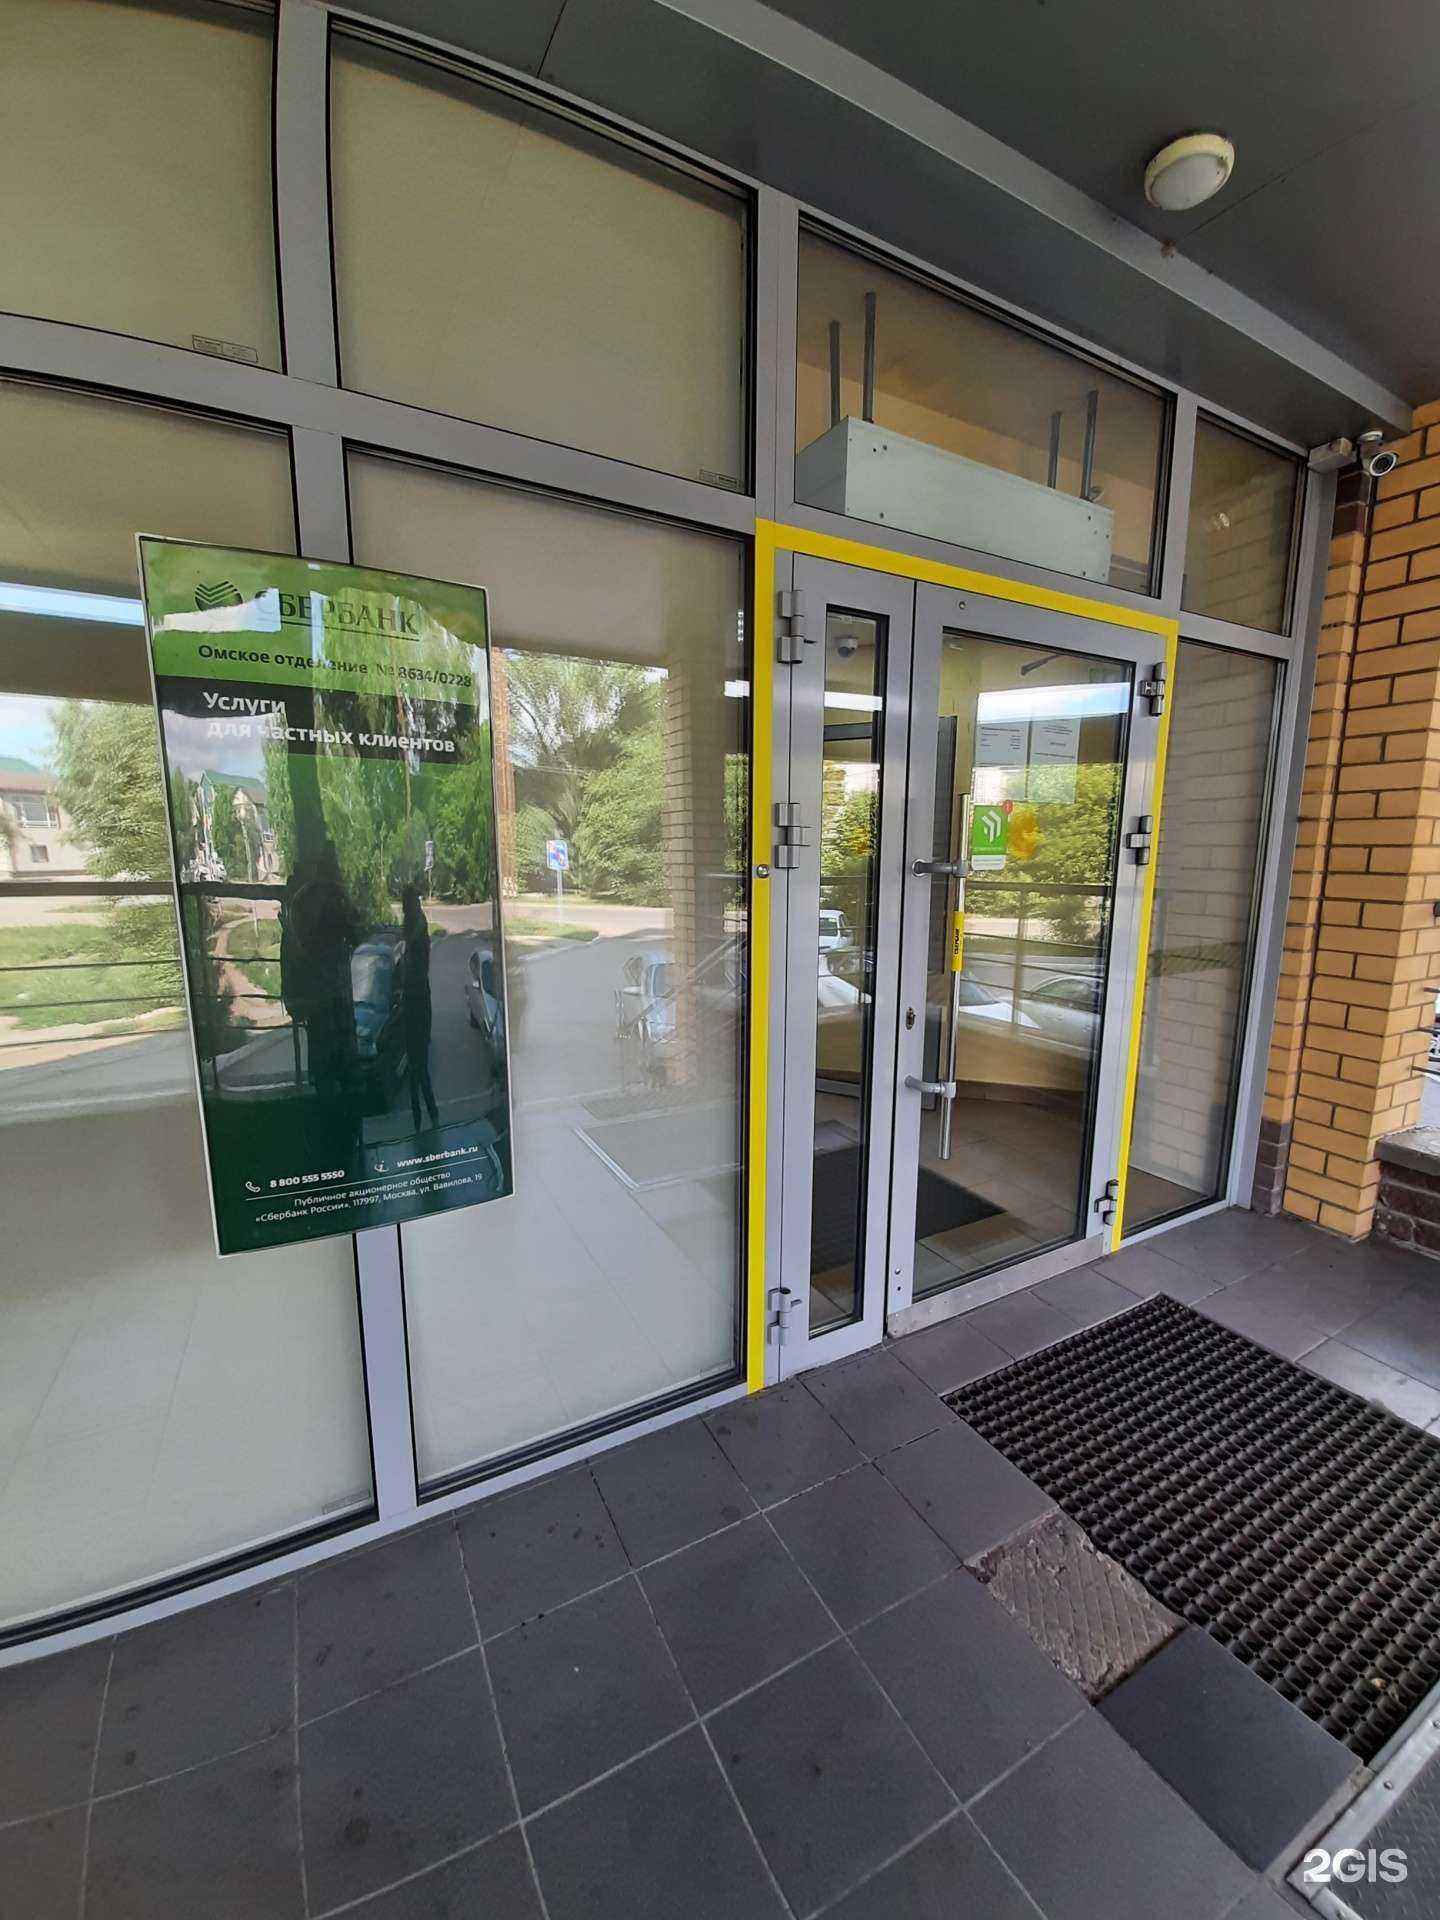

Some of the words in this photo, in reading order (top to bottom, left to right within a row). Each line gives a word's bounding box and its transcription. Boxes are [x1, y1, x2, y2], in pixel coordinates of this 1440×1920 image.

[198, 644, 270, 664] Омское
[398, 666, 473, 688] 8634/0228
[202, 691, 286, 716] Услуги
[207, 721, 252, 740] для
[257, 724, 354, 746] частных
[358, 731, 455, 753] клиентов
[396, 1145, 479, 1169] www.sberbank.ru
[270, 1180, 277, 1188] 8
[278, 1176, 300, 1187] 800
[301, 1173, 320, 1184] 555
[320, 1169, 345, 1181] 5550
[294, 1191, 347, 1207] Публичное
[348, 1181, 408, 1199] акционерное
[409, 1171, 451, 1187] общество
